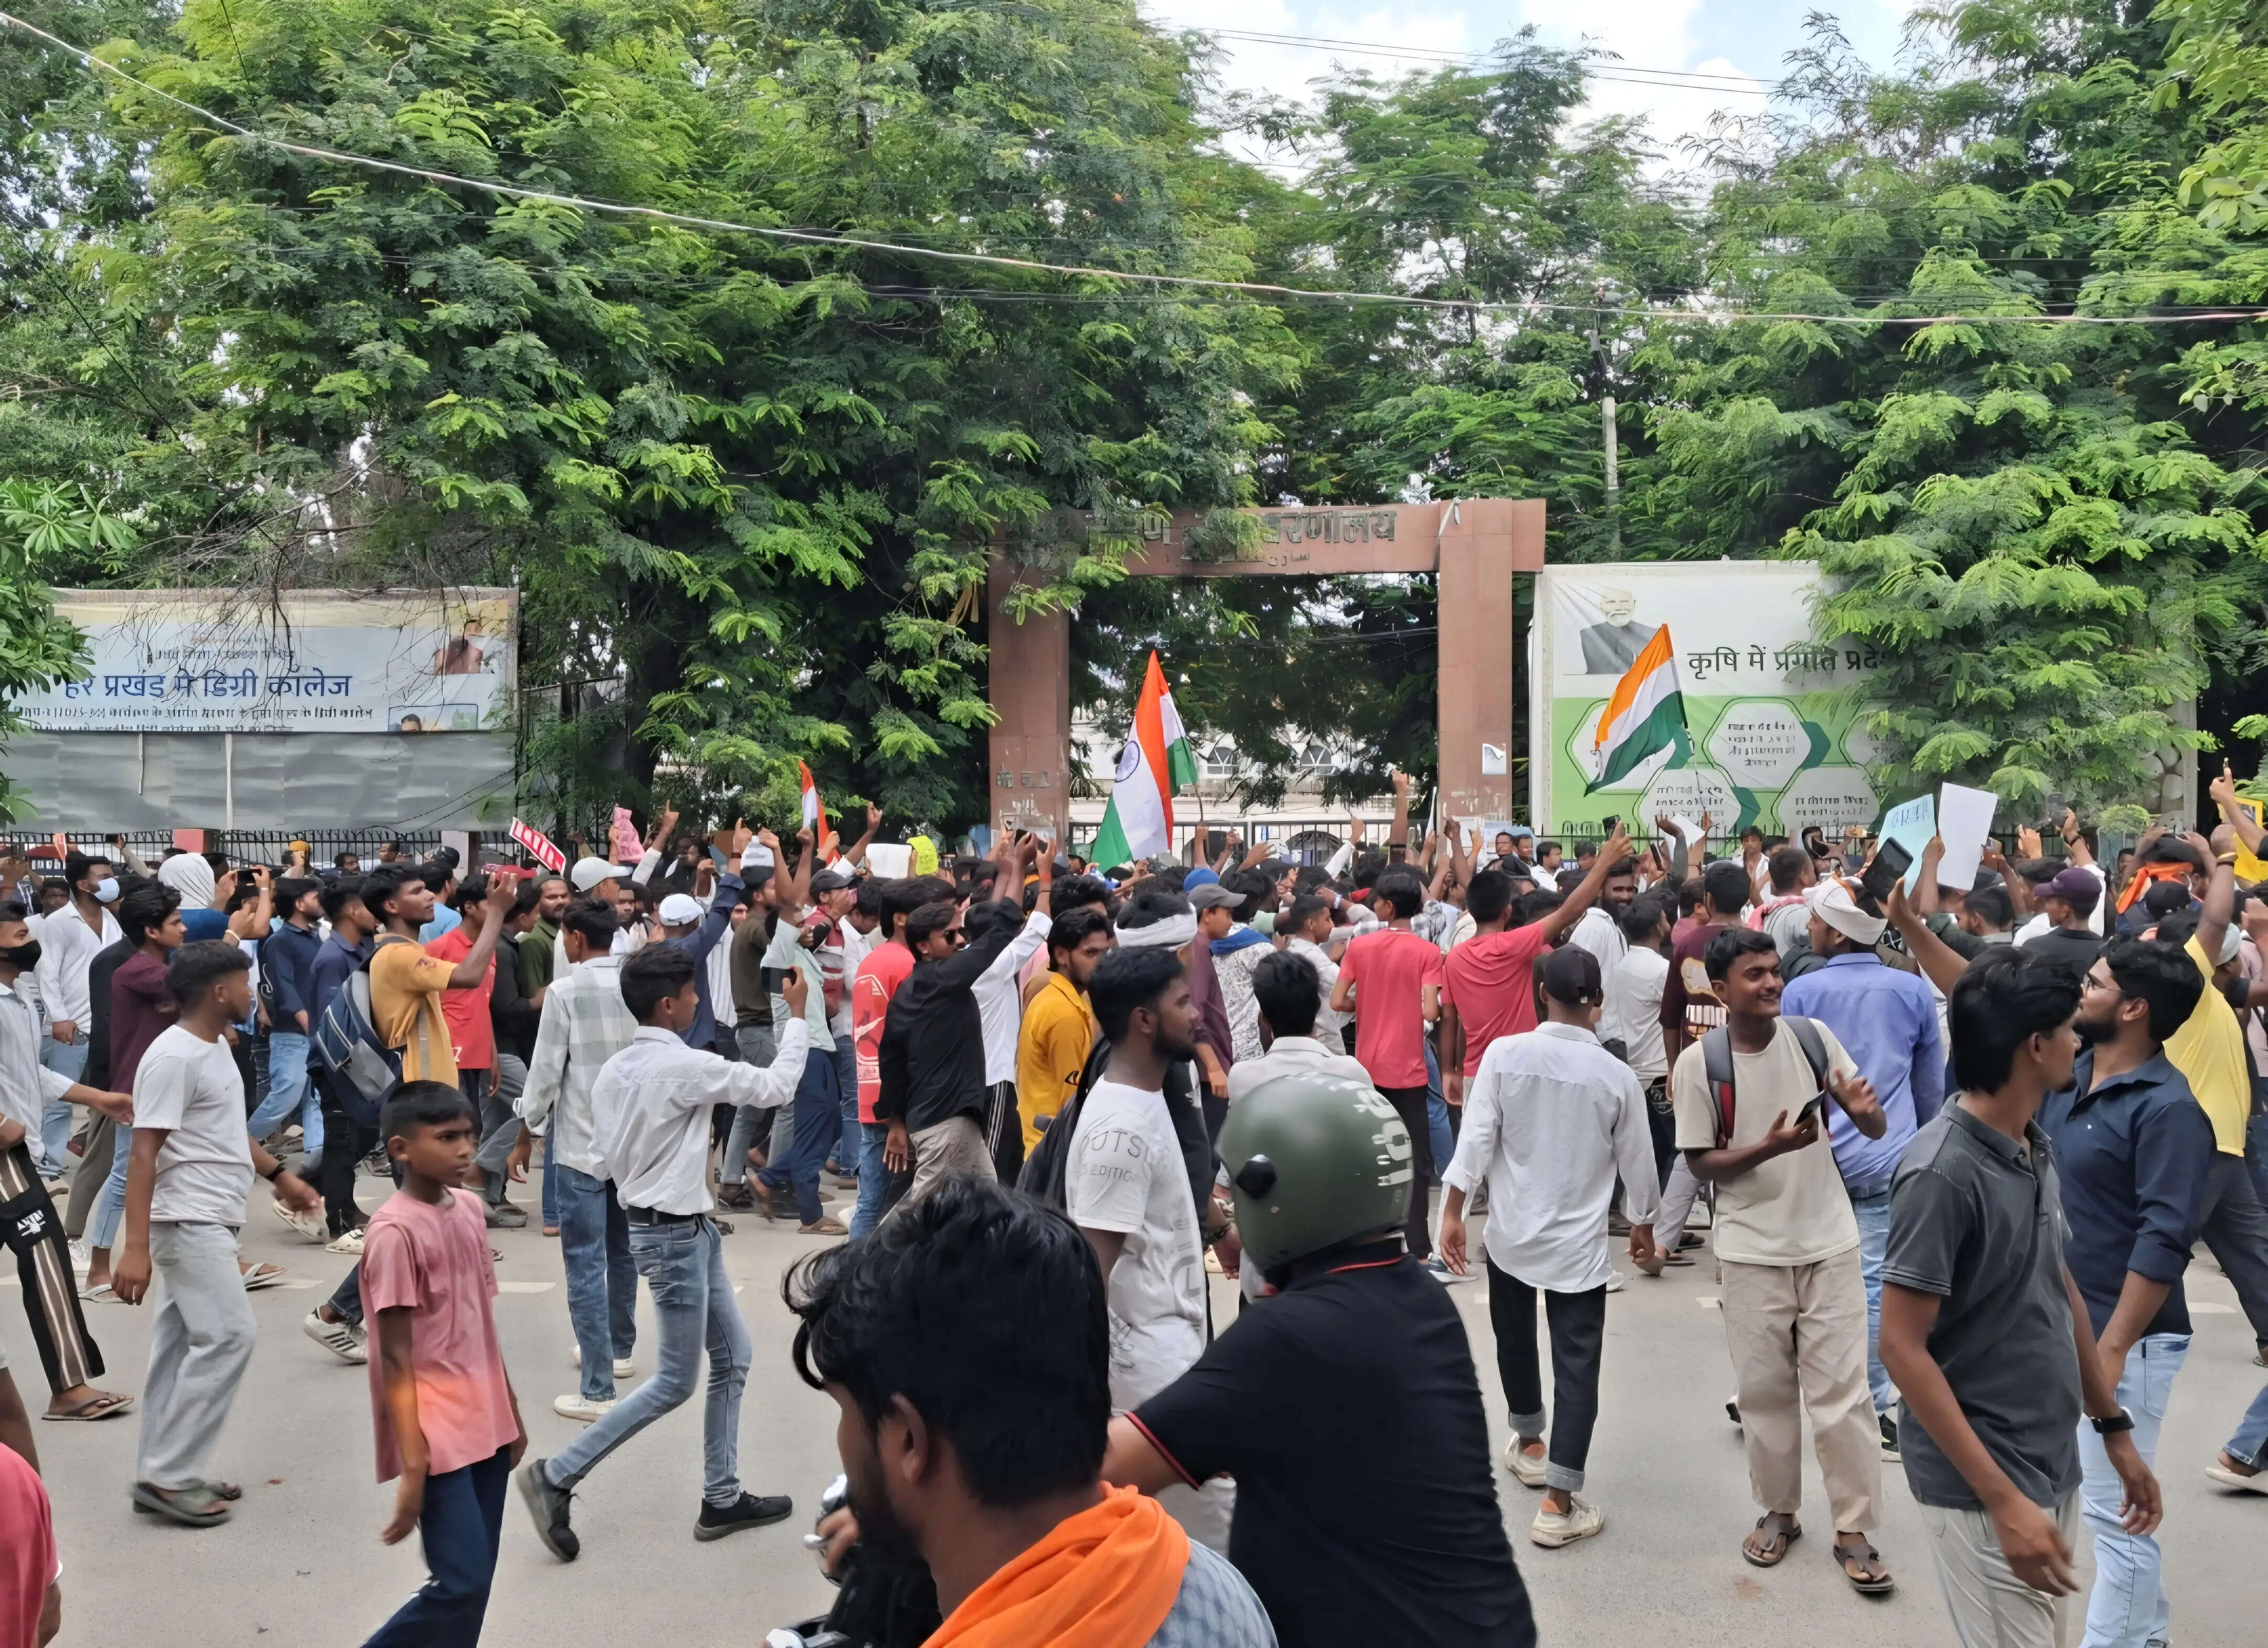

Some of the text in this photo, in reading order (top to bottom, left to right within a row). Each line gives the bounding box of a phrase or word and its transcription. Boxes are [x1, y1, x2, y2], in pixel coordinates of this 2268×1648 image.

[1687, 646, 1740, 679] कृषि
[1748, 645, 1766, 671] में
[202, 668, 259, 697] डिग्री
